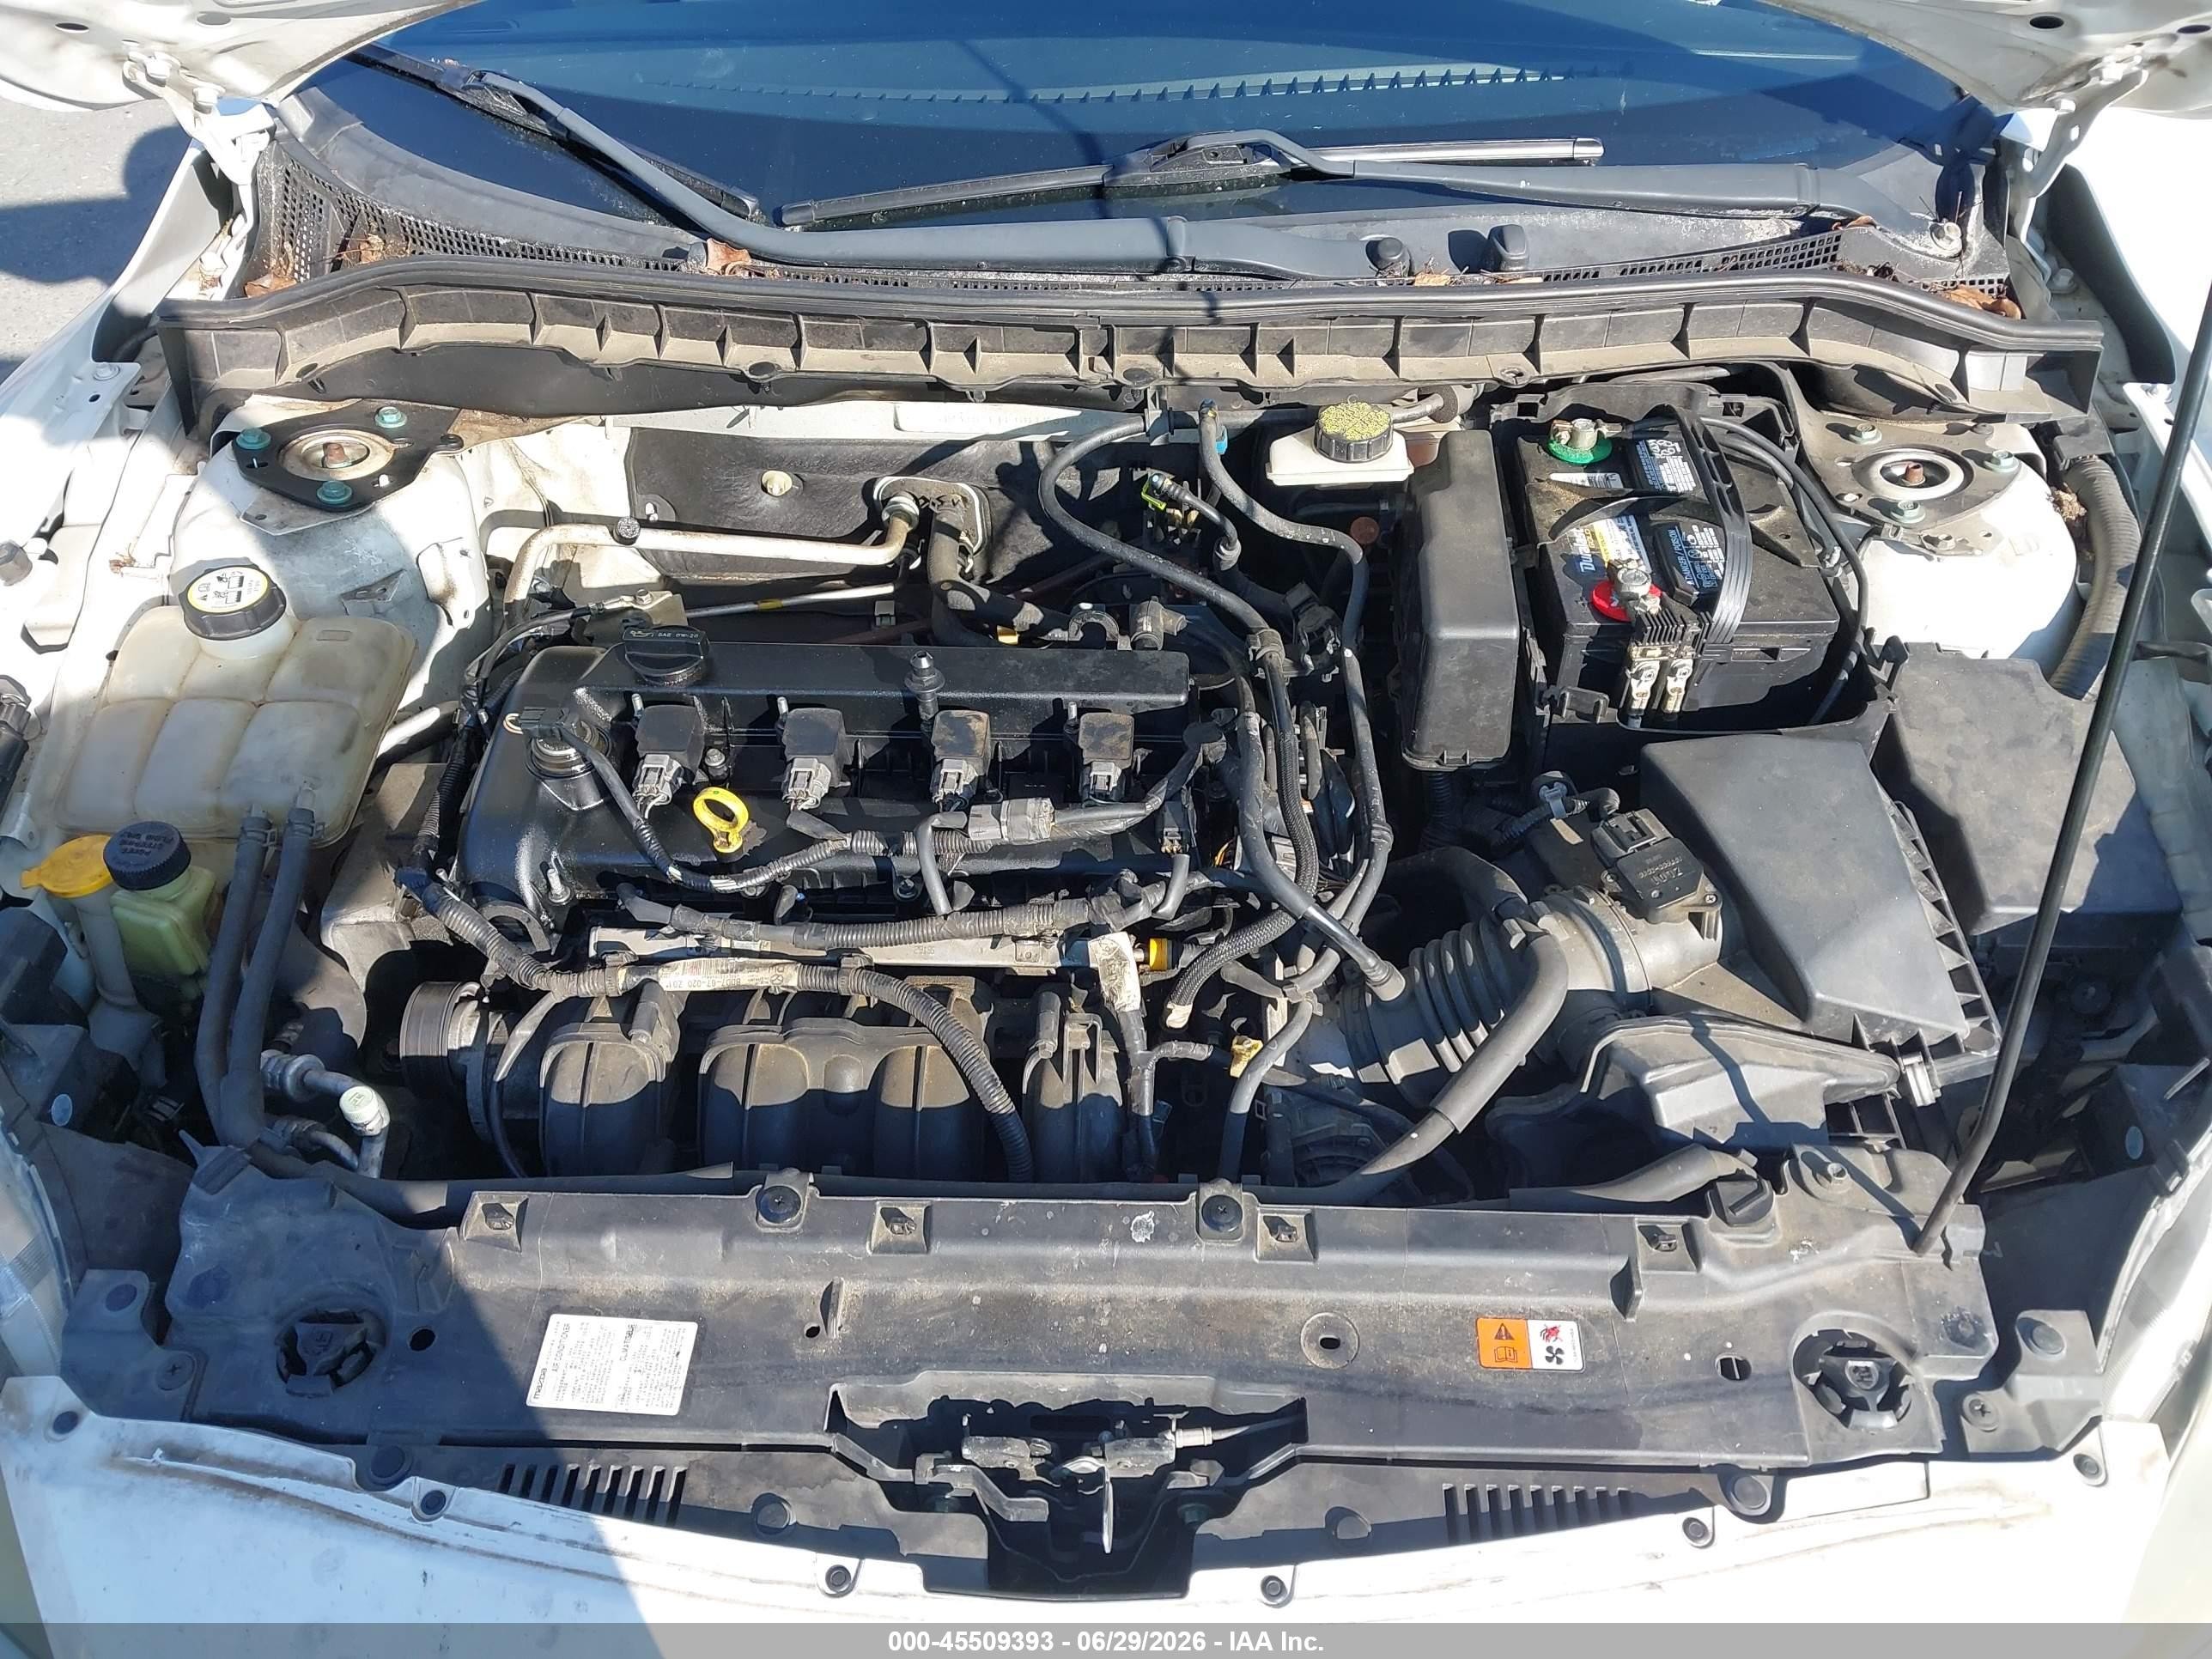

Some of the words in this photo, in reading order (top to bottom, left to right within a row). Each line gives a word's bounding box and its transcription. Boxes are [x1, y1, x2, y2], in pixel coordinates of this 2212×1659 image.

[1583, 528, 1595, 548] GOLD
[1668, 529, 1682, 550] POISON
[1571, 526, 1595, 573] Duralast
[1677, 556, 1692, 580] DANGER
